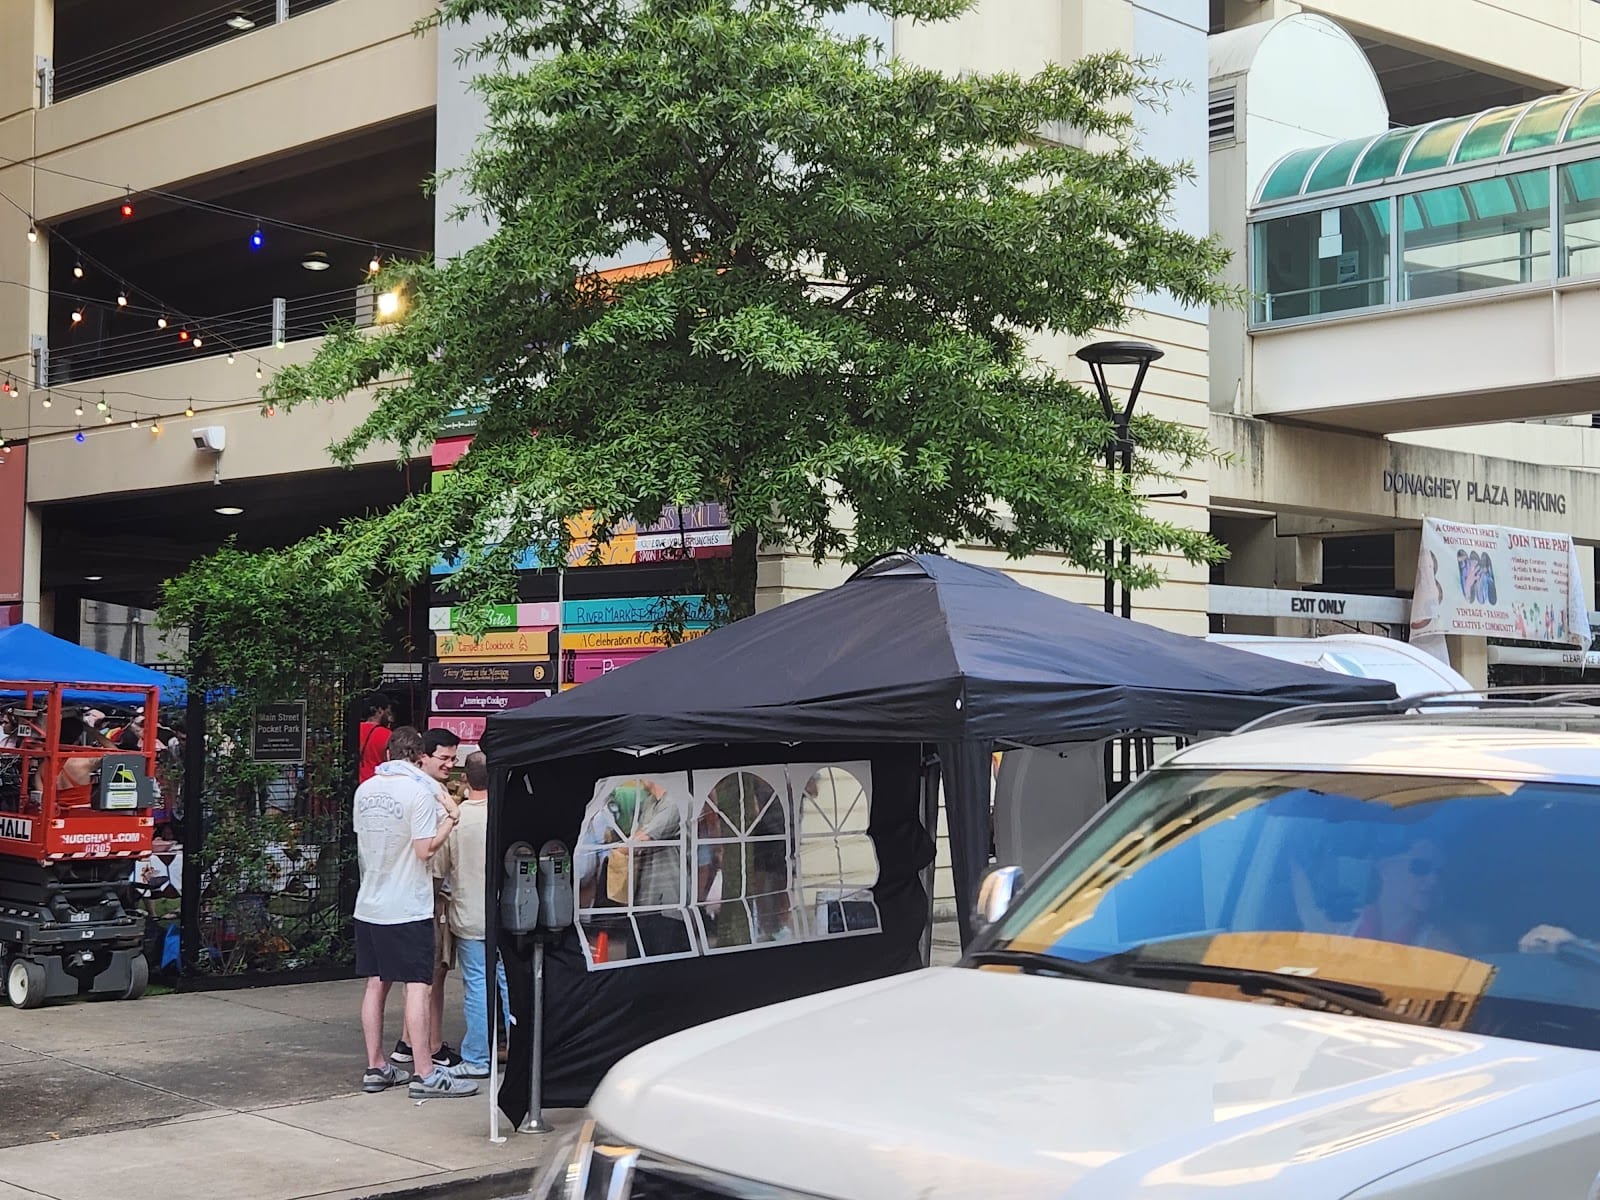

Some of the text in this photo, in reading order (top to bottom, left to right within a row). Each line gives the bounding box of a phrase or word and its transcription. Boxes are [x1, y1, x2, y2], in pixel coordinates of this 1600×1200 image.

[1383, 469, 1566, 515] DONAGHEY PLAZA PARKING
[1443, 536, 1497, 549] MONTHLY MARKET
[1508, 533, 1530, 550] JOIN
[1531, 536, 1551, 550] THE
[1291, 597, 1346, 614] EXIT ONLY
[1456, 608, 1483, 617] VINTAGE
[1453, 620, 1514, 632] CREATIVE COMMUNITY
[486, 640, 514, 651] Cookbook
[589, 632, 632, 648] Celebration
[633, 632, 642, 645] of
[278, 713, 300, 722] Street
[257, 724, 300, 733] Pocket Park
